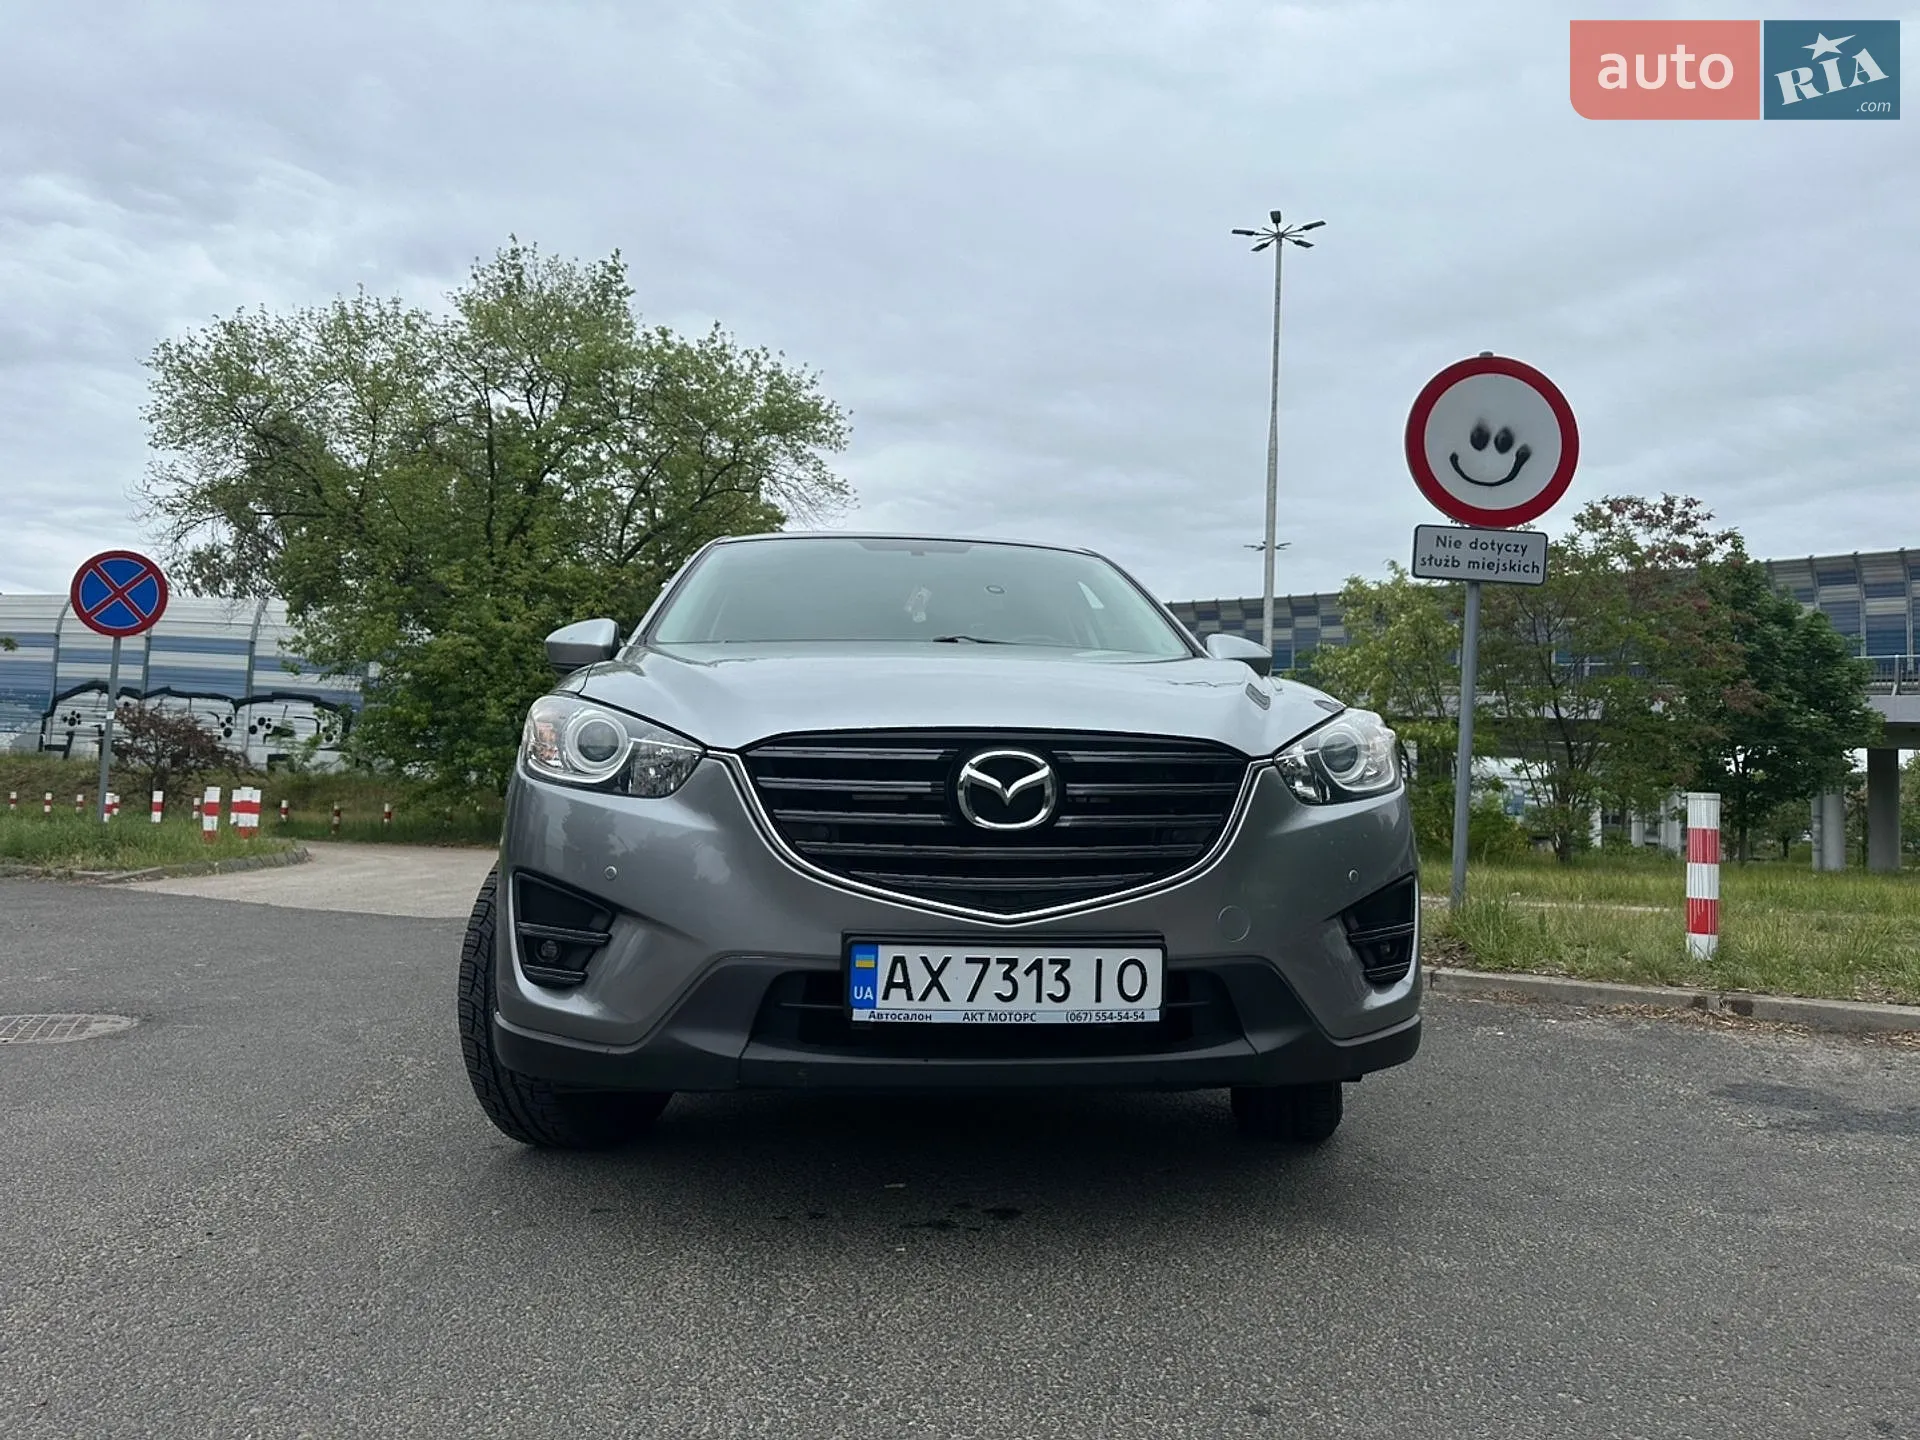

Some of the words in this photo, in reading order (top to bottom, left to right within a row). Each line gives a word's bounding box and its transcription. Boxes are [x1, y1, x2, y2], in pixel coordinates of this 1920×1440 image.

[1436, 535, 1462, 549] Nie
[1469, 537, 1528, 557] dotyczy
[1420, 554, 1460, 568] służb
[1468, 557, 1540, 574] miejskich
[881, 955, 952, 1003] AX
[964, 956, 1071, 1004] 7313
[1095, 958, 1148, 1003] IO
[854, 987, 874, 1000] UA
[868, 1010, 932, 1022] Автосалон
[962, 1012, 986, 1023] АКТ
[988, 1012, 1037, 1023] МОТОРС
[1065, 1012, 1092, 1023] (067)
[1095, 1011, 1146, 1022] 554-54-54
